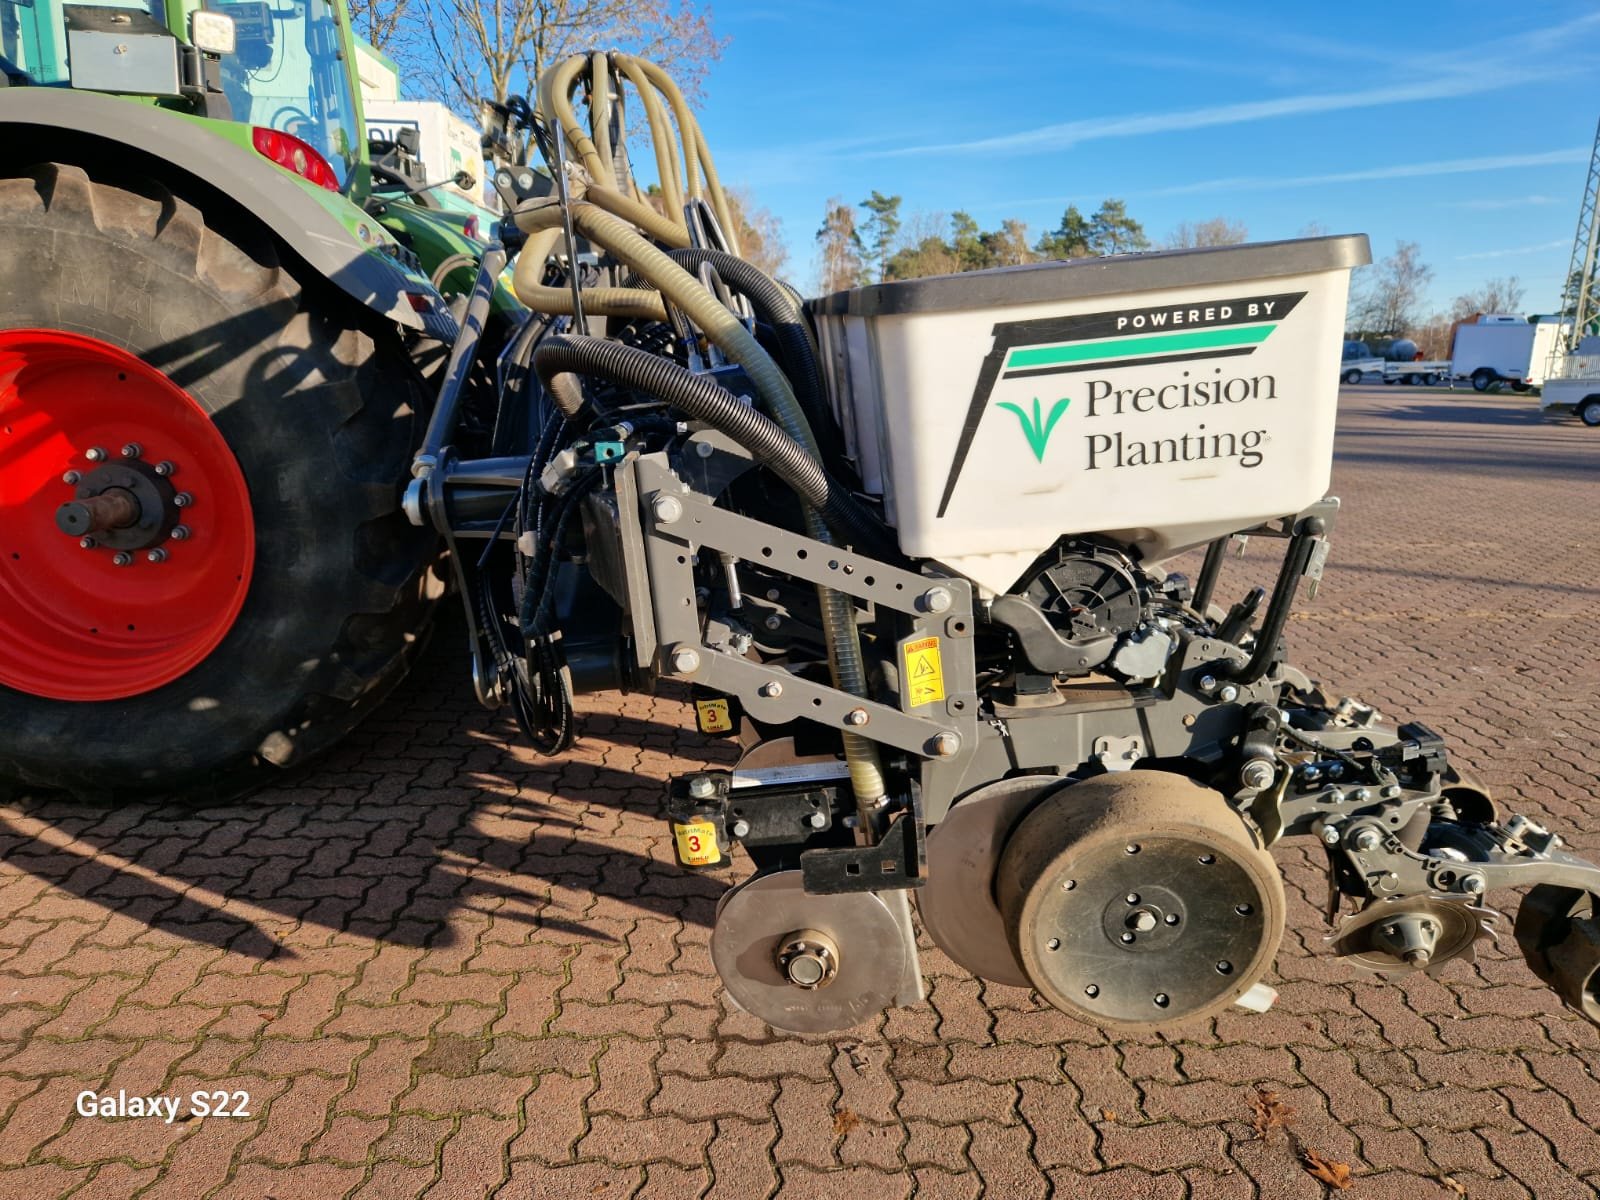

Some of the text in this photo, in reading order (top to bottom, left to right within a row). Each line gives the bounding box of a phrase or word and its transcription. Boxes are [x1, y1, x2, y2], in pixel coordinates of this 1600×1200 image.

[1117, 301, 1276, 330] POWERED BY
[1084, 367, 1278, 418] Precision
[1084, 424, 1267, 469] Planting
[707, 709, 717, 723] 3
[688, 835, 701, 853] 3
